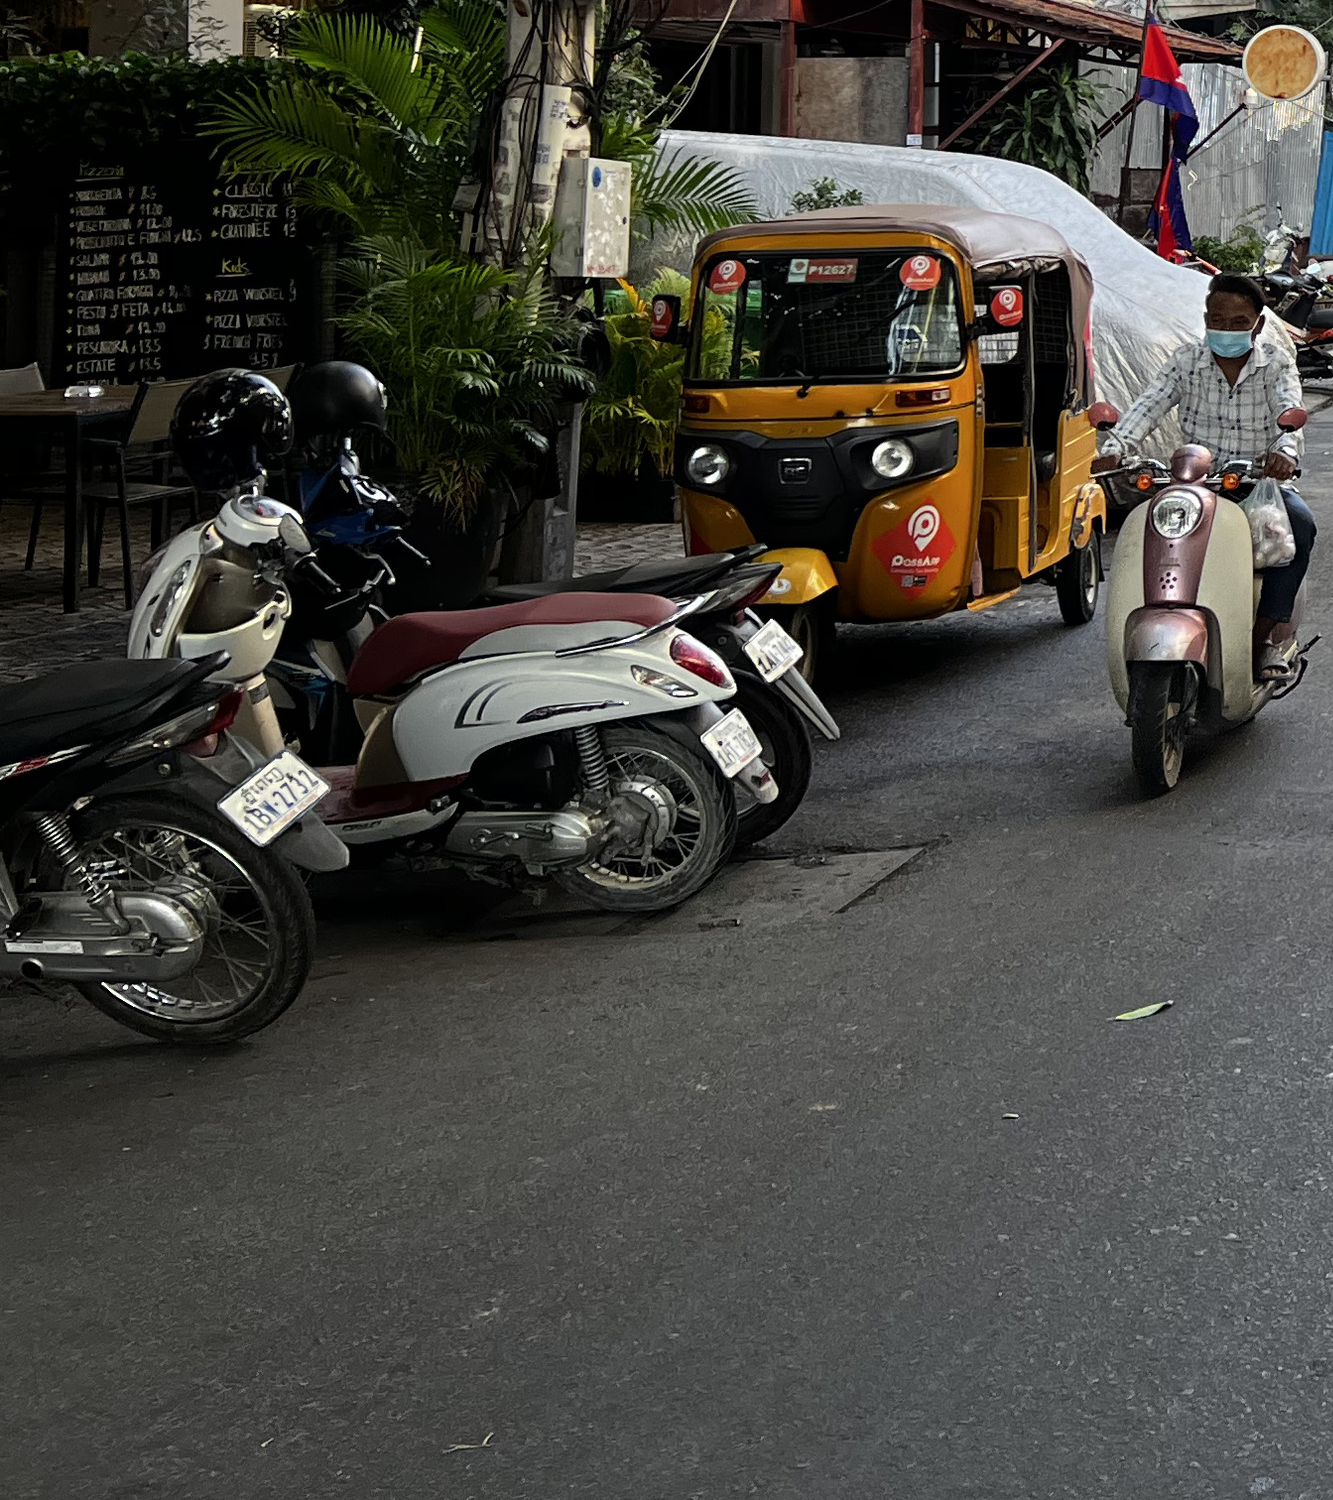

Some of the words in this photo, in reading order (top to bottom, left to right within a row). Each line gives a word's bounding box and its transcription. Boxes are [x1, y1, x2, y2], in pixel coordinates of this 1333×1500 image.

[809, 265, 853, 275] P12627
[121, 302, 150, 317] FETA
[76, 358, 116, 374] ESTATE
